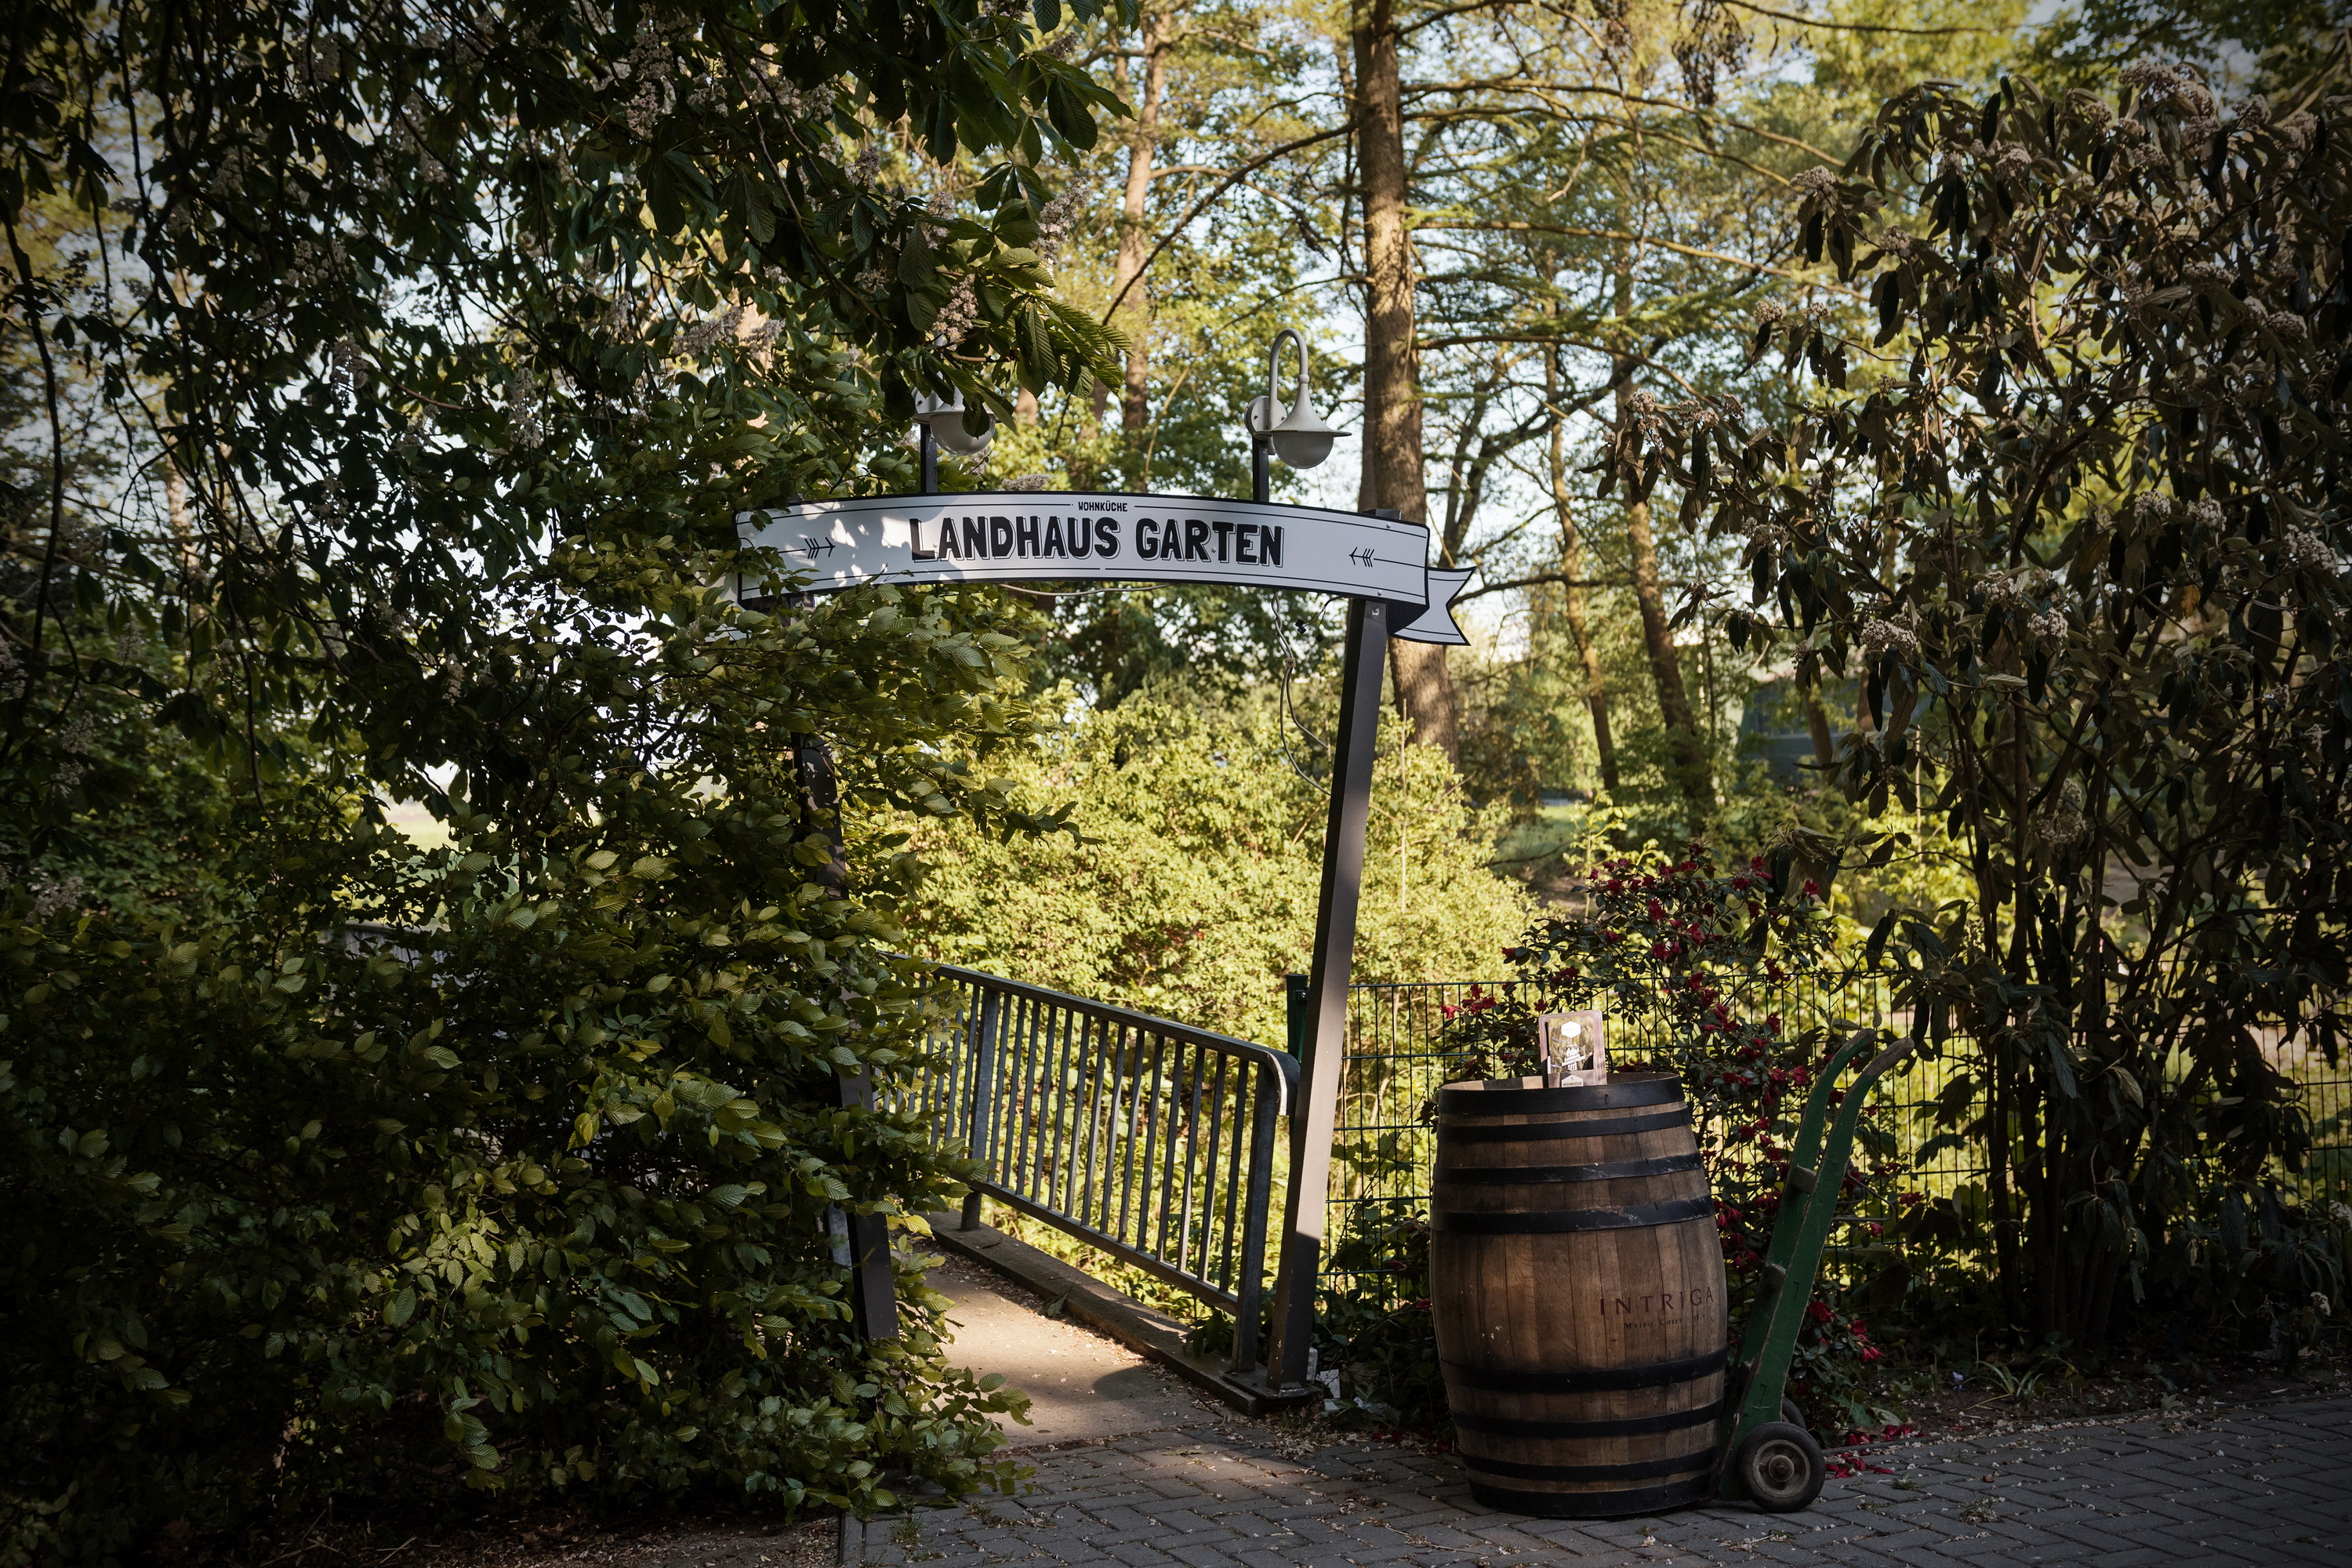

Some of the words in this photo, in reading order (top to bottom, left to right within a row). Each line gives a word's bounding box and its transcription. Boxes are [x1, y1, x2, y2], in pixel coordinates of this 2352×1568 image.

[1078, 500, 1128, 512] WOHNKÜCHE
[909, 515, 1120, 564] LANDHAUS
[1135, 517, 1284, 568] GARTEN
[1599, 1287, 1714, 1316] INTRIGA
